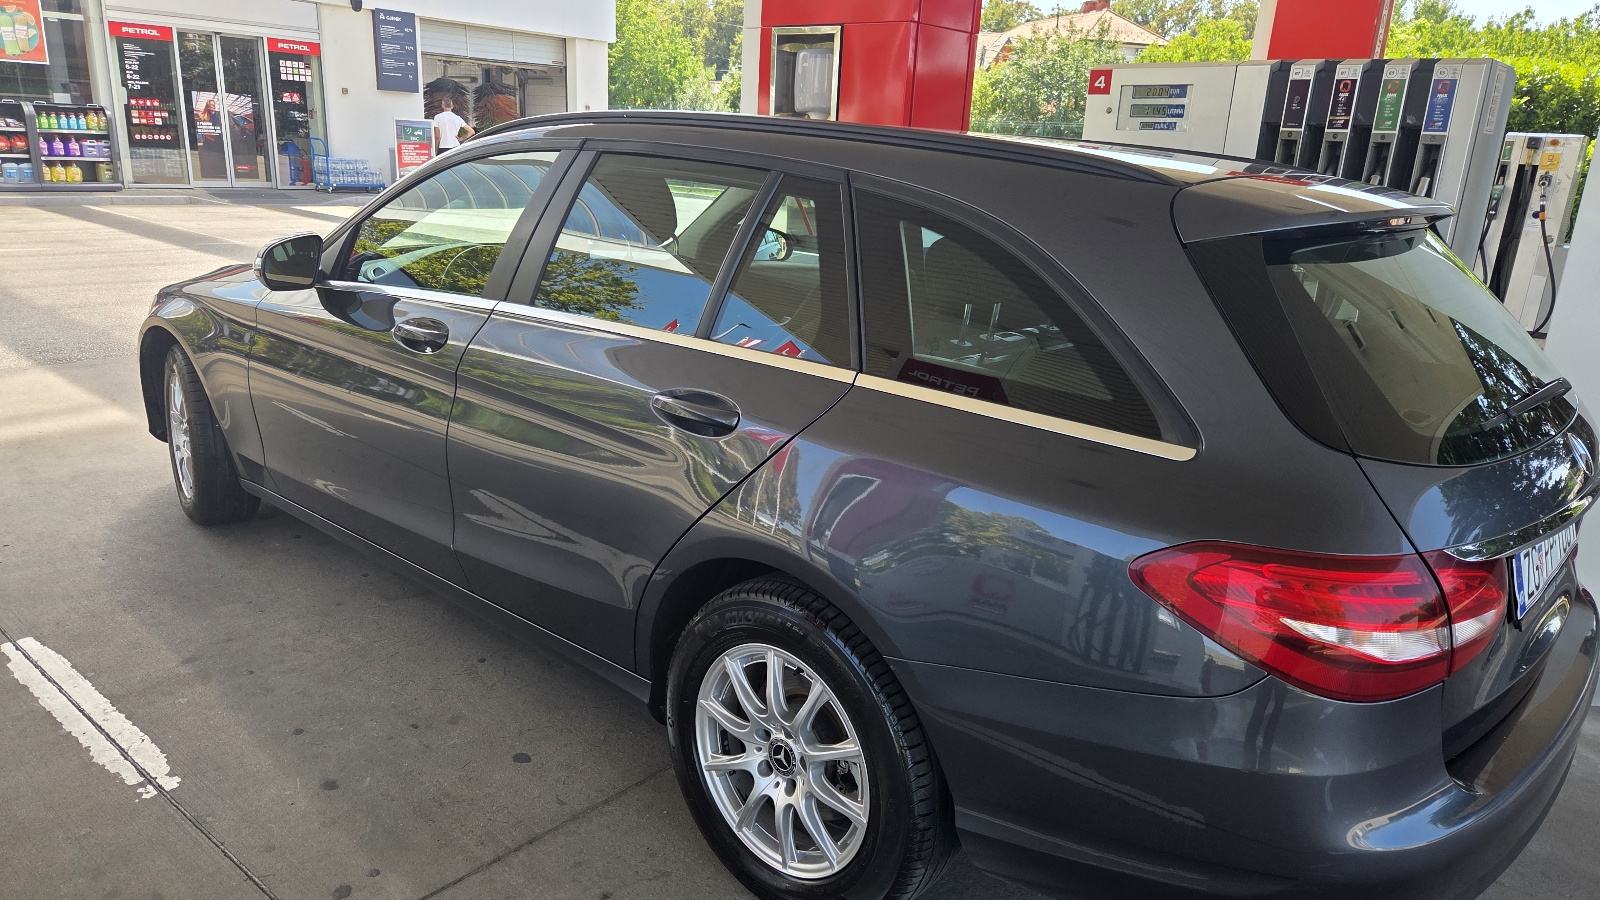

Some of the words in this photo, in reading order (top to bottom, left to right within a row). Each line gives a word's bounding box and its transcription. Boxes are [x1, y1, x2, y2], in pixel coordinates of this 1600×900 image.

[121, 26, 161, 36] PETROL
[277, 42, 310, 52] PETROL
[1094, 75, 1106, 89] 4
[1523, 547, 1541, 598] ZG
